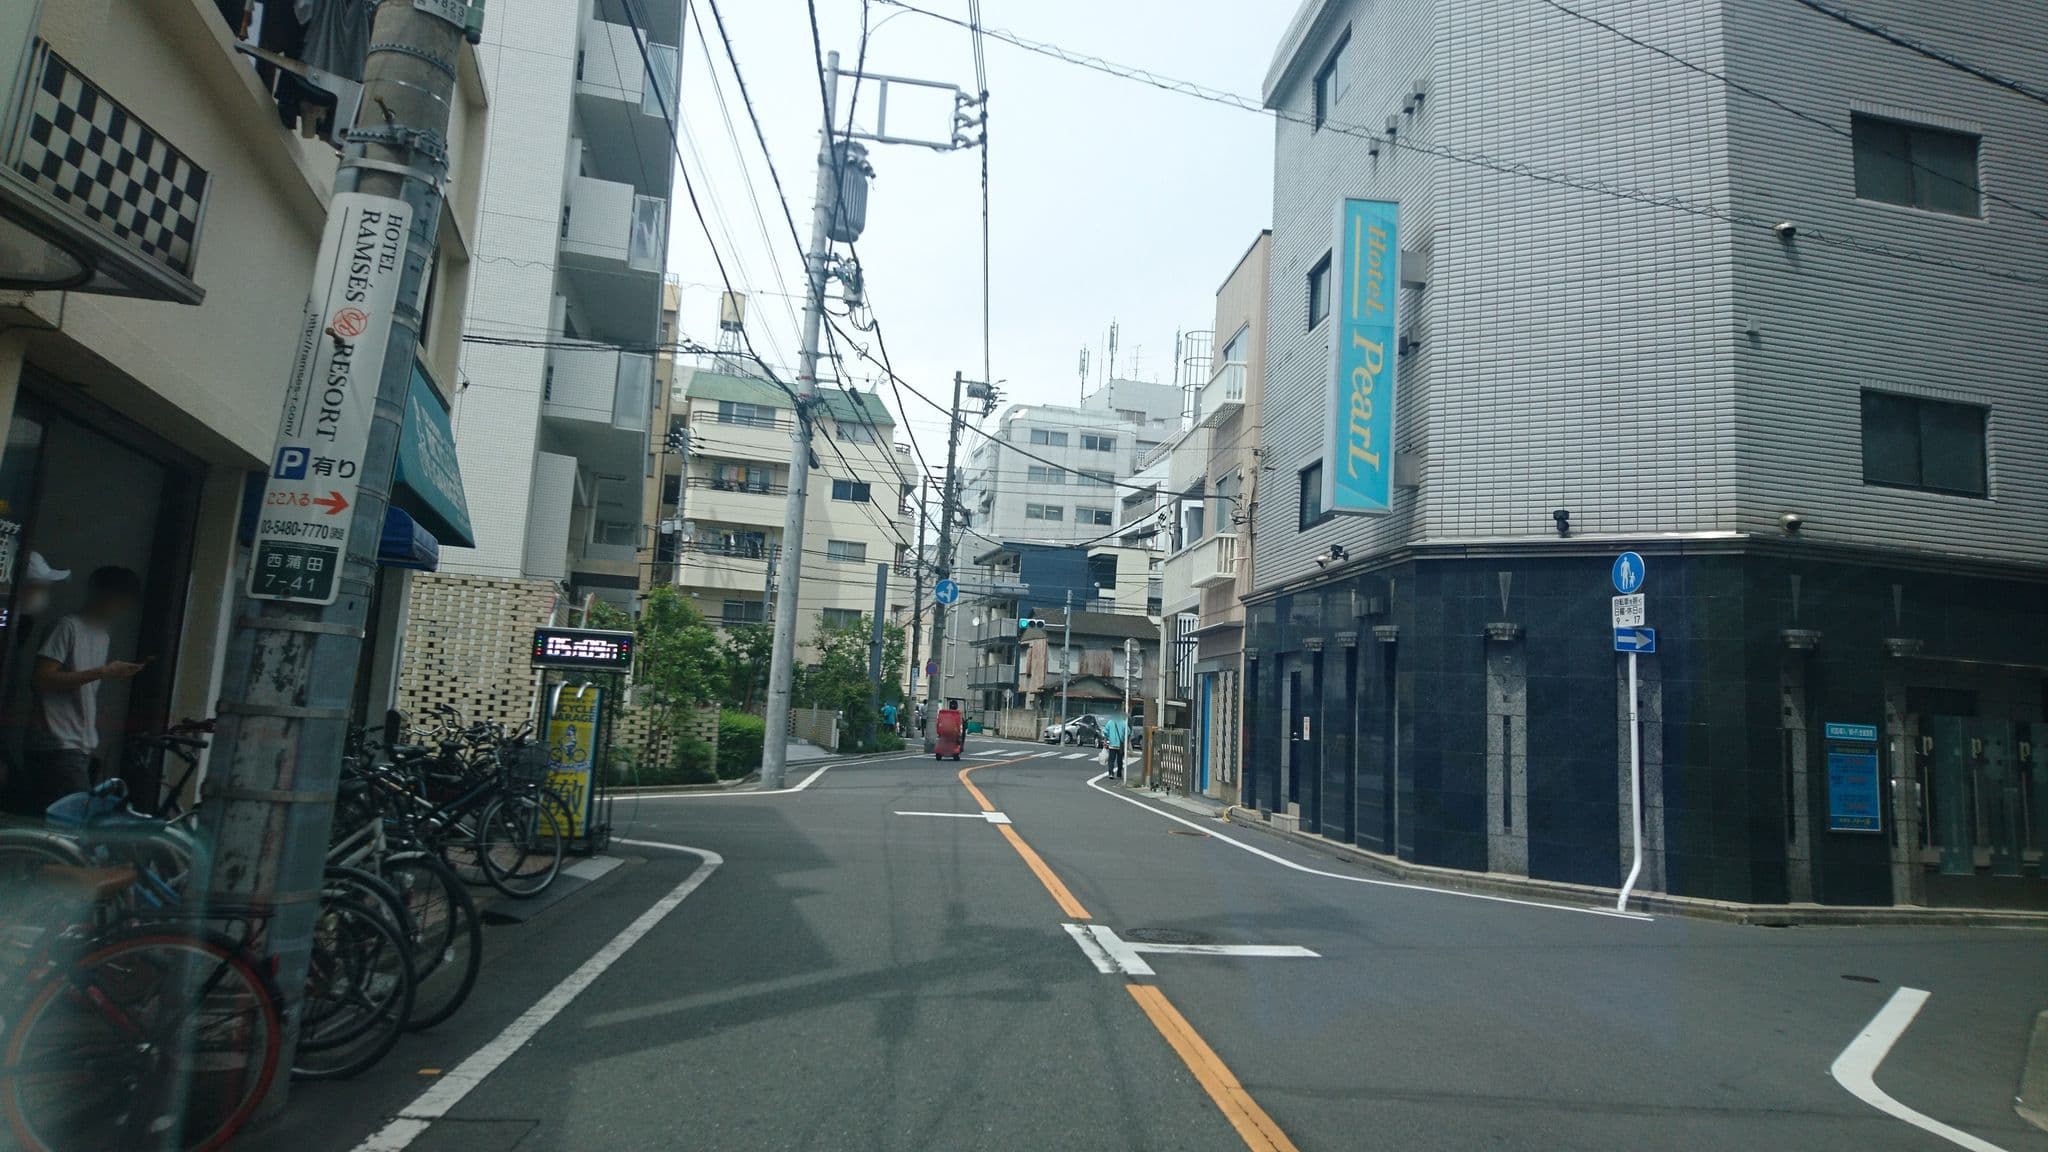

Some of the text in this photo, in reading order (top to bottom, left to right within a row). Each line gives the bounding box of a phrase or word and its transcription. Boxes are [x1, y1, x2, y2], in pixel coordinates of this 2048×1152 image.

[378, 212, 403, 274] HOTEL
[316, 208, 381, 443] RAMSÉS RESORT
[279, 450, 356, 479] P 有り
[266, 491, 311, 507] ここ入る
[261, 519, 329, 540] 03-5480-7770
[266, 553, 324, 572] 西蒲田
[264, 574, 316, 592] 7-41
